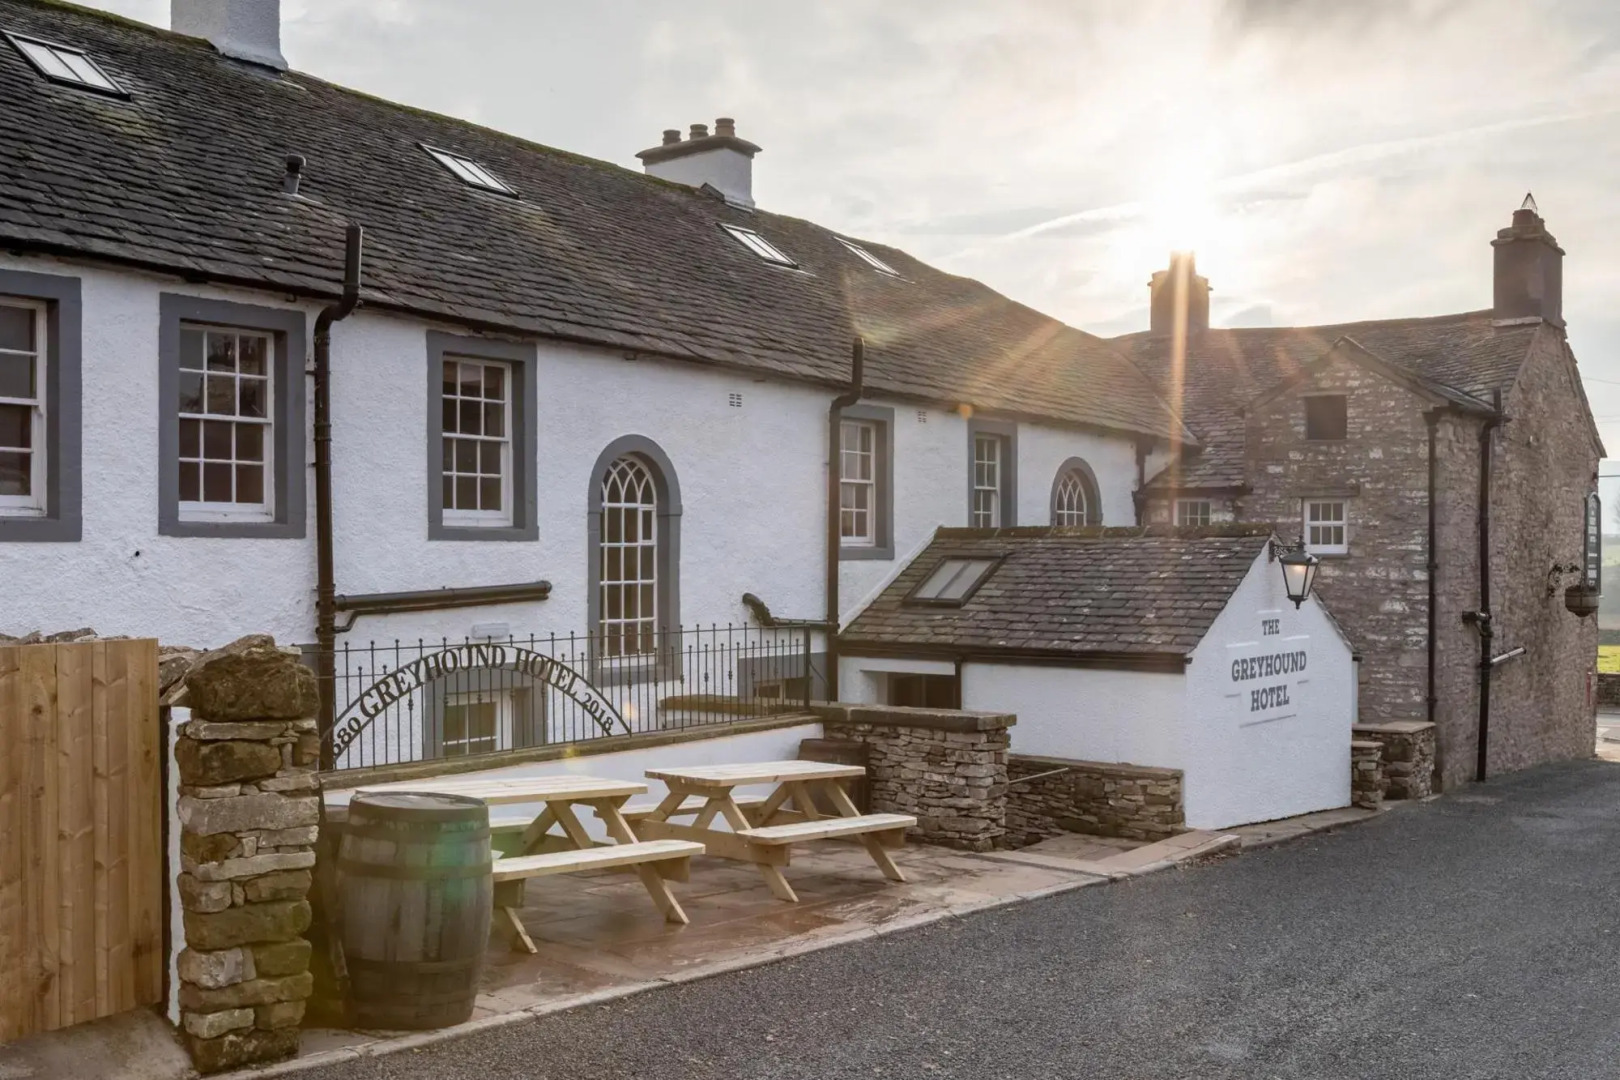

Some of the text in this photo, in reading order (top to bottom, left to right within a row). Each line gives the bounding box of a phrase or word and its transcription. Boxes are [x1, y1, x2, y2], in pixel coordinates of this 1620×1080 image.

[1262, 619, 1280, 636] THE
[1231, 651, 1307, 682] GREYHOUND
[360, 643, 506, 718] GREYHOUND
[513, 647, 578, 700] HOTEL
[581, 692, 614, 732] 2018
[1250, 684, 1290, 712] HOTEL
